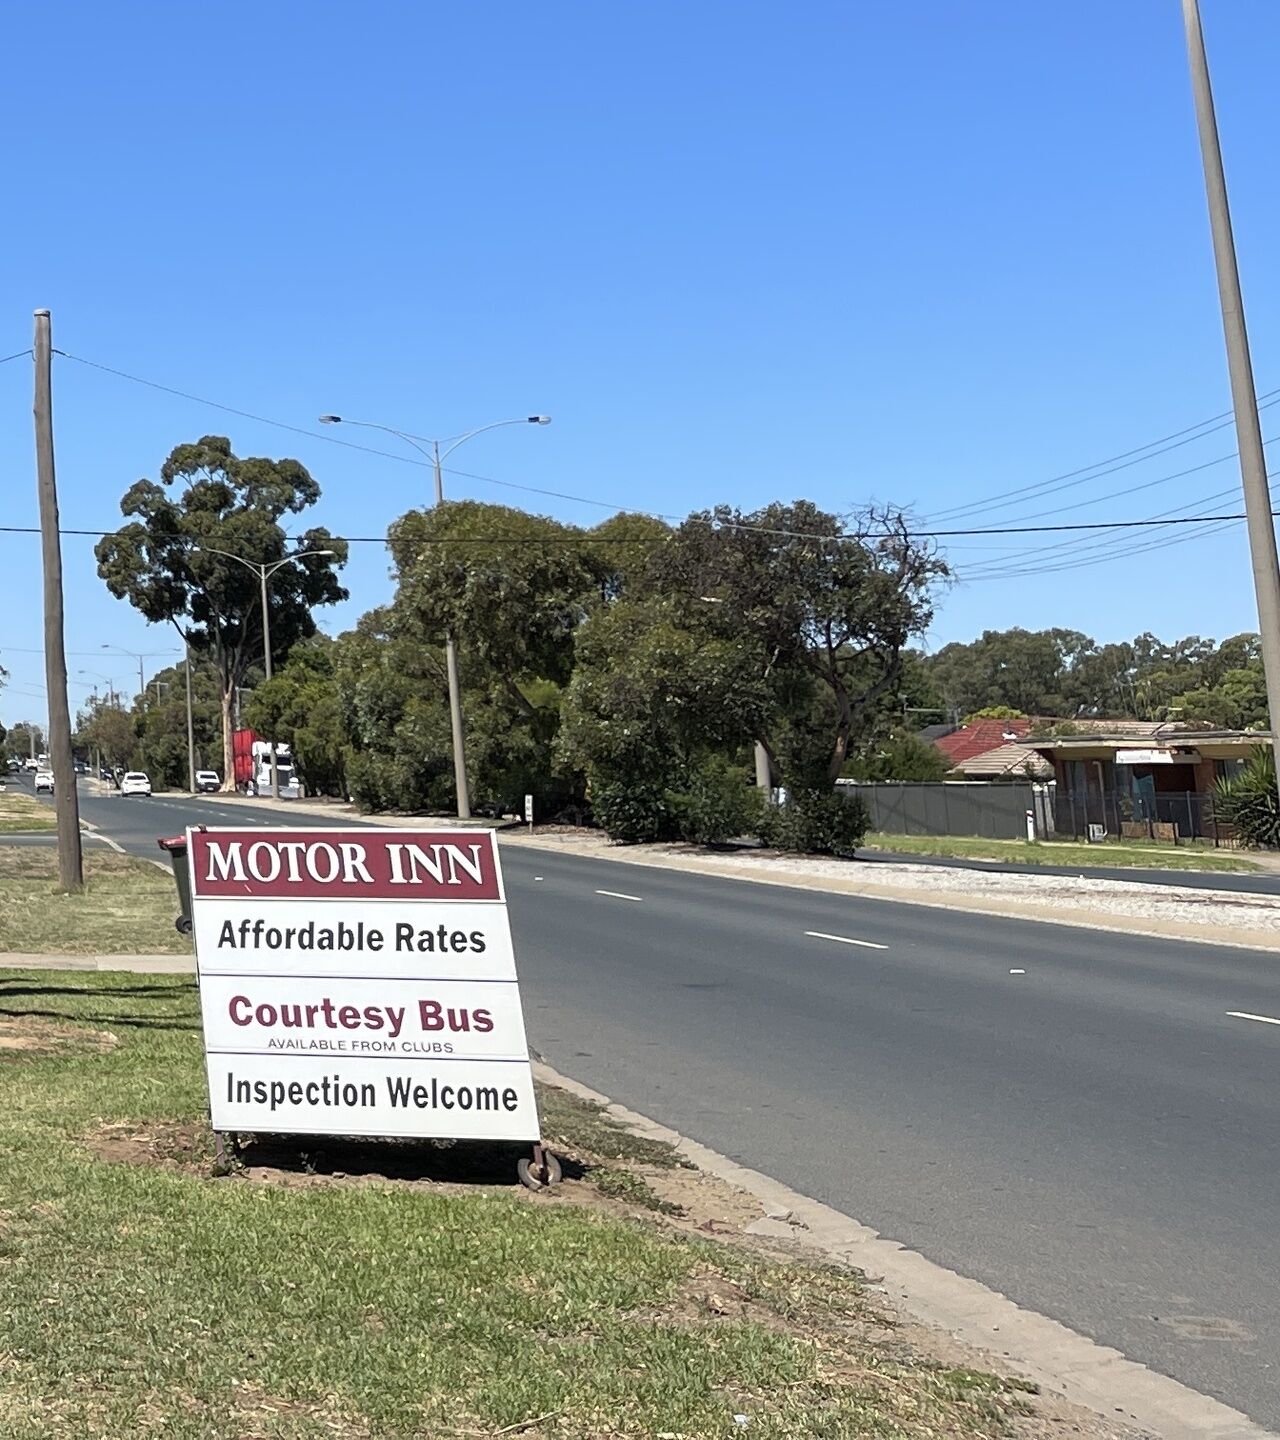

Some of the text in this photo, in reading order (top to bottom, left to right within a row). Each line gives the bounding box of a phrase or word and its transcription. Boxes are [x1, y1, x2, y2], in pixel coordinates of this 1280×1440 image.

[204, 841, 485, 886] MOTOR INN
[217, 919, 487, 954] Affordable Rates
[228, 996, 495, 1038] Courtesy Bus
[268, 1038, 454, 1054] AVAILABLE FROM CLUBS
[226, 1072, 519, 1112] Inspection Welcome
